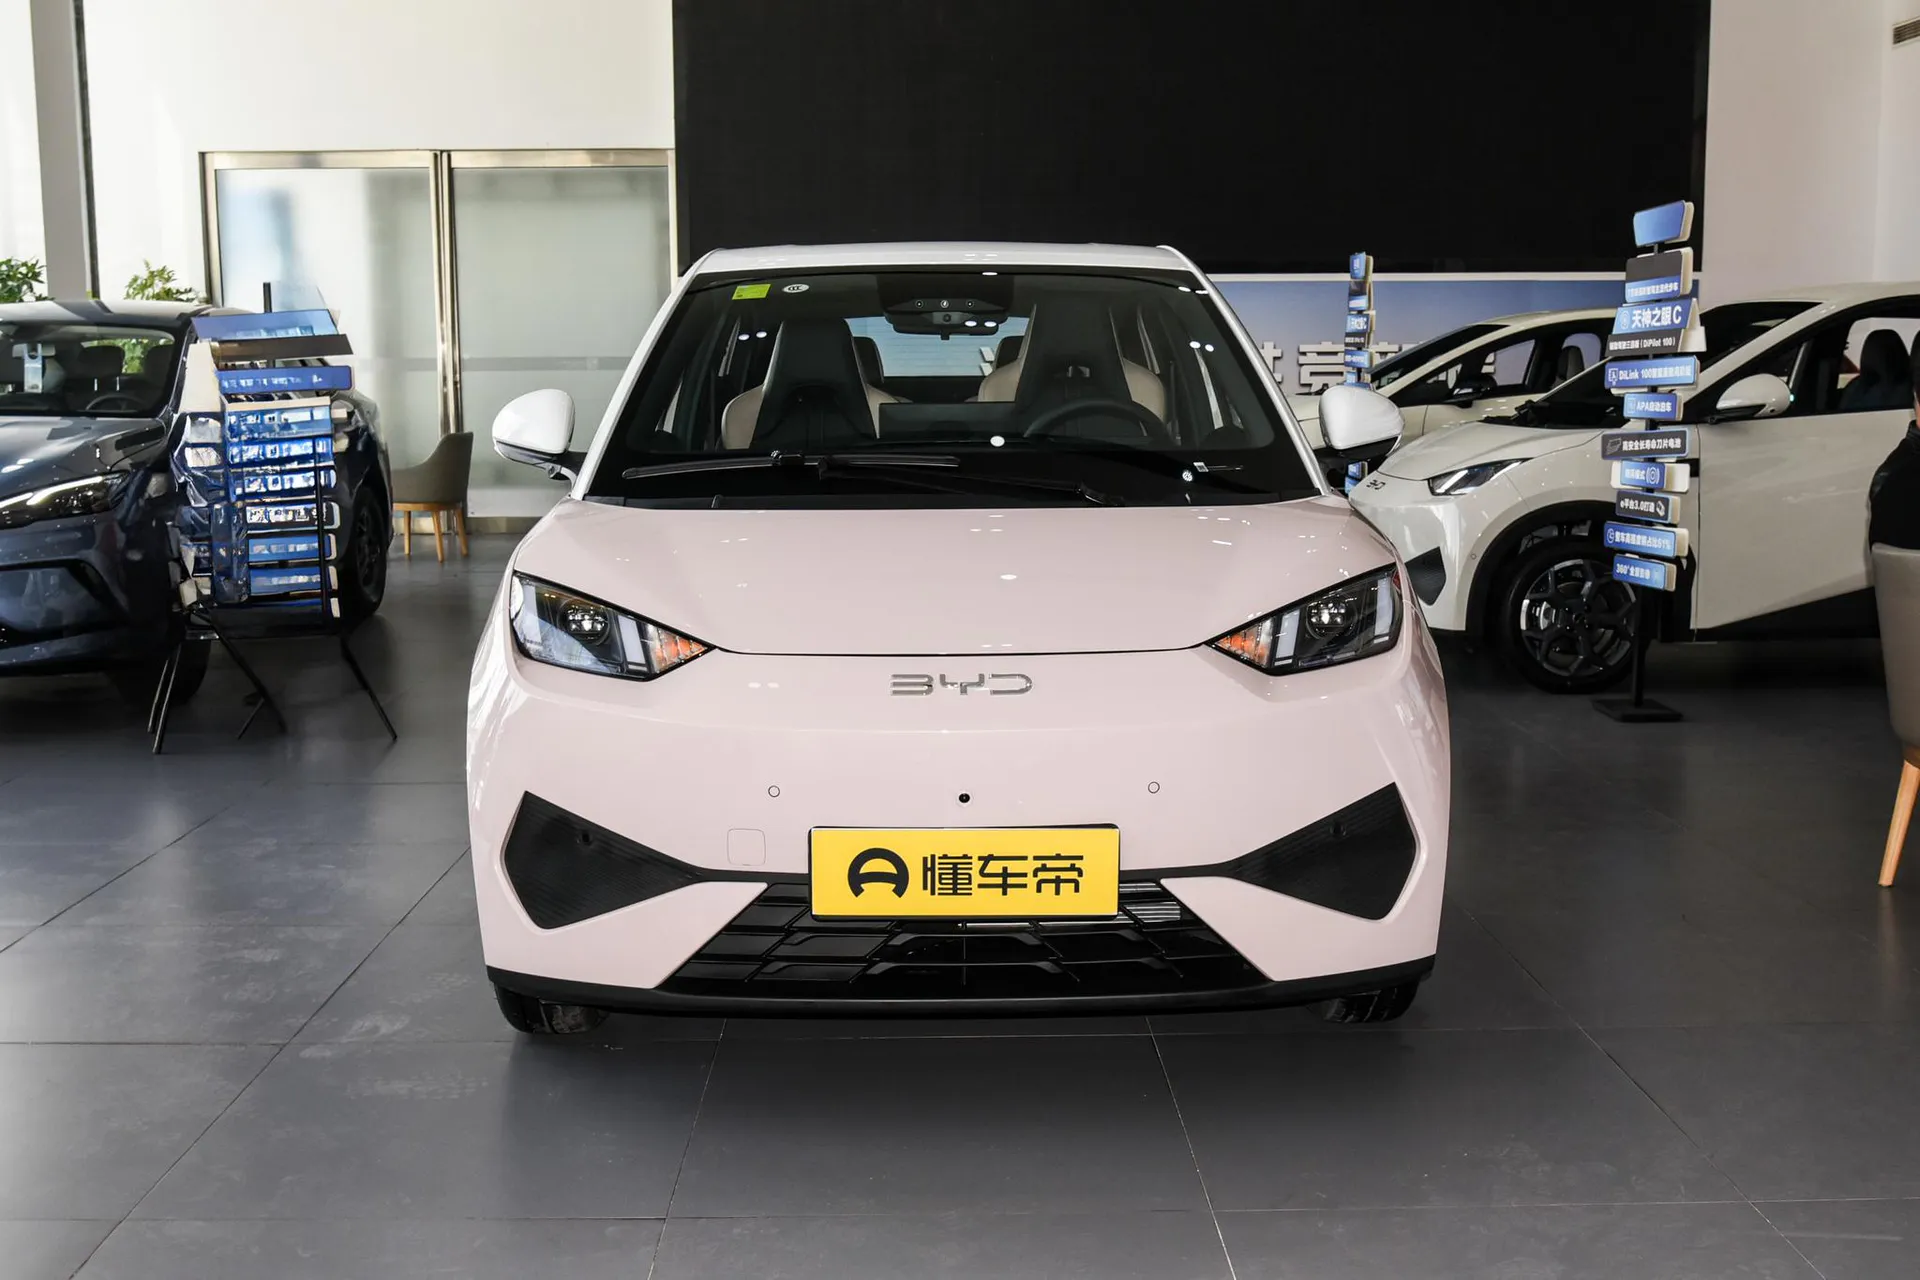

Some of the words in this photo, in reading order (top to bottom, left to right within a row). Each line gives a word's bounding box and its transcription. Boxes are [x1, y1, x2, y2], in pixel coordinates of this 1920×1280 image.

[1632, 305, 1682, 329] 天神之眼C
[1619, 368, 1639, 381] DiLink
[1622, 437, 1682, 451] 高安全长寿命刀片电池
[890, 673, 1033, 696] BYD
[922, 853, 1084, 896] 懂车帝
